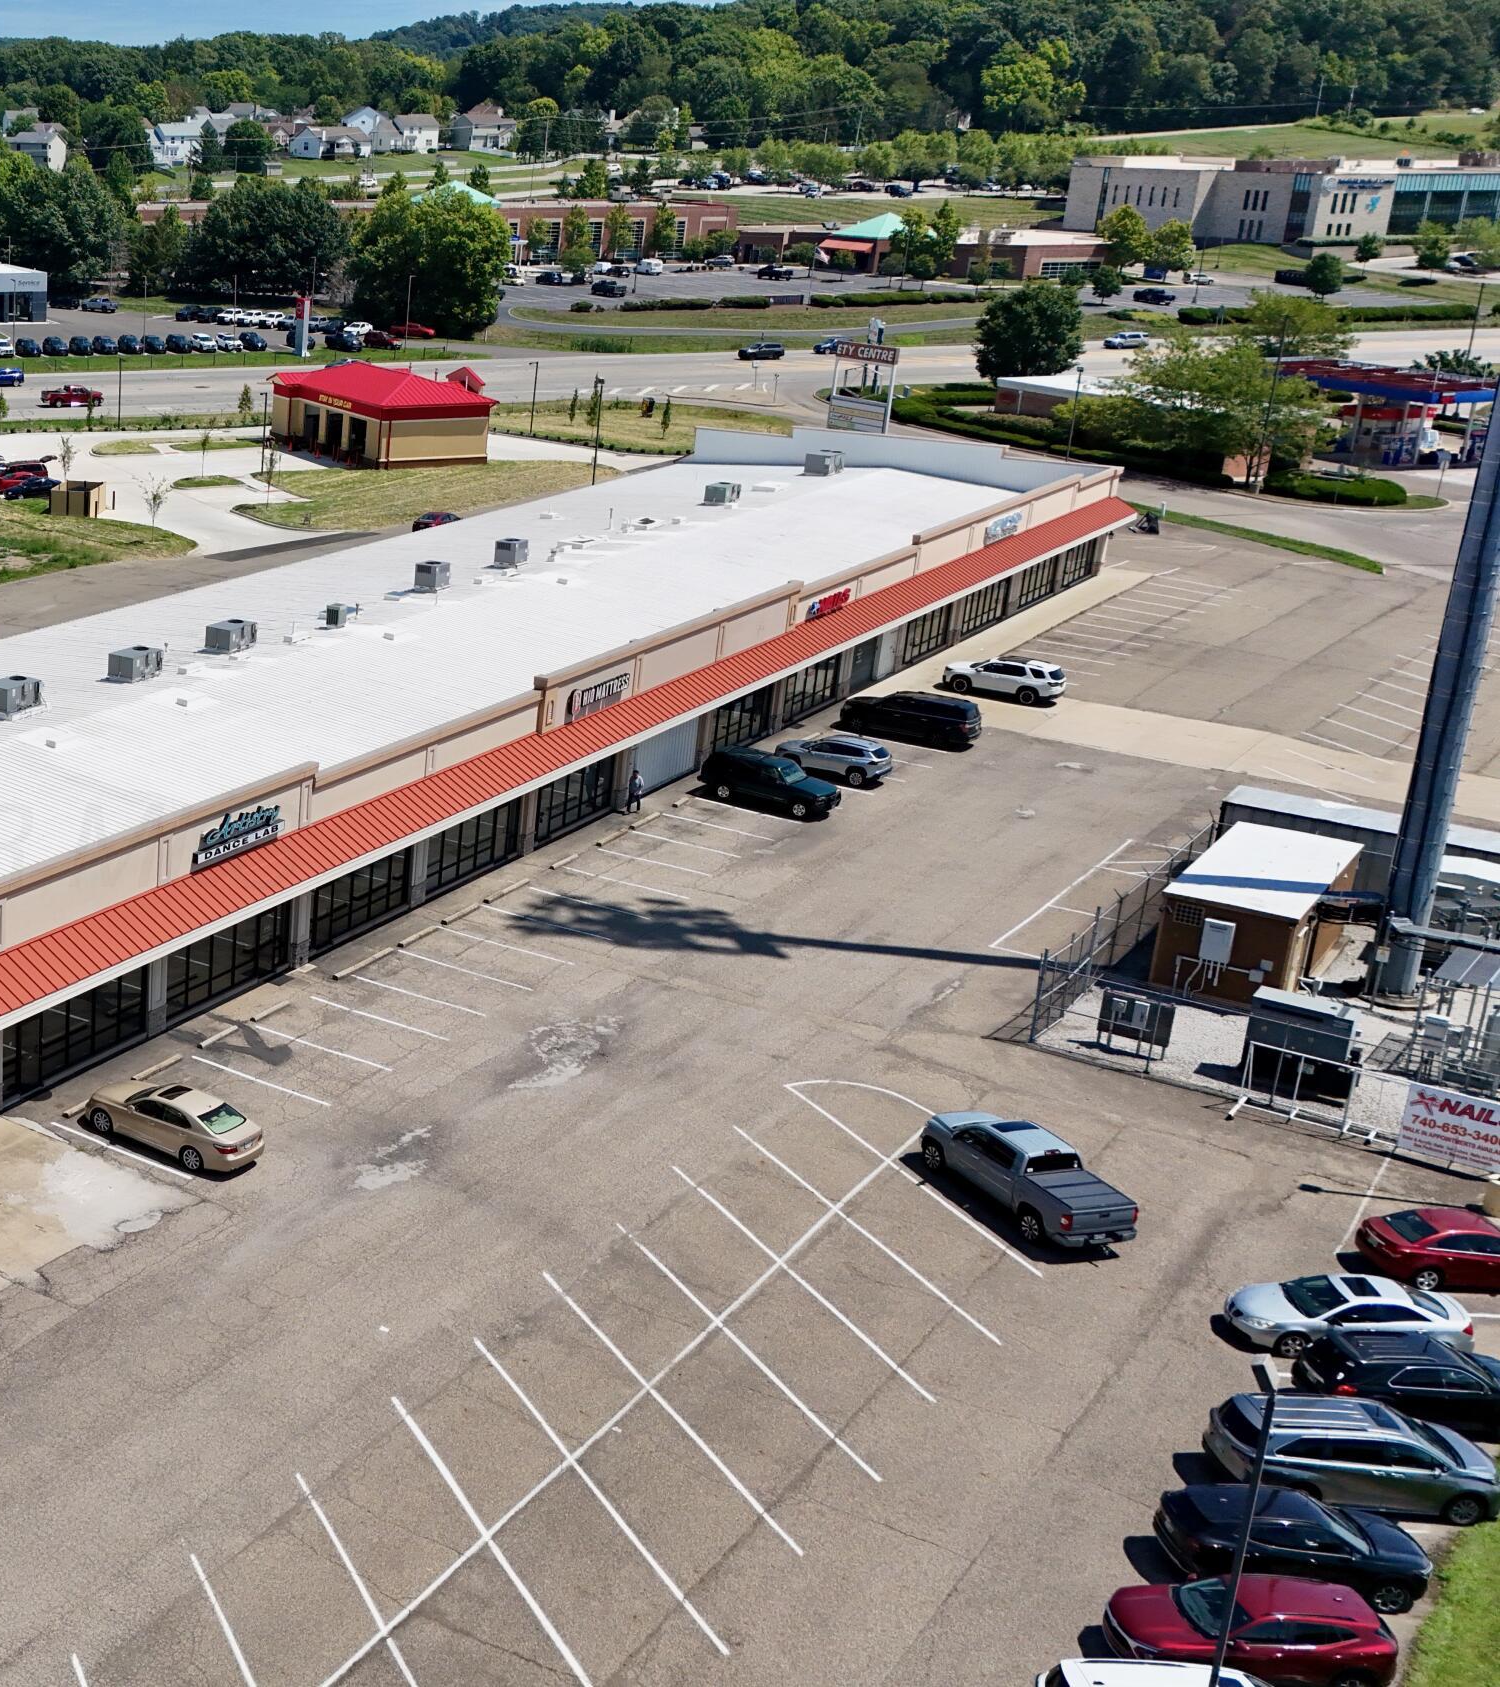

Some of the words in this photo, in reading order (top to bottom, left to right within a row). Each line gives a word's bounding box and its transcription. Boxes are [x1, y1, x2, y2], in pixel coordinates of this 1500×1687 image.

[837, 344, 856, 356] ETY
[857, 346, 895, 361] CENTRE
[596, 673, 630, 701] MATTRESS
[204, 805, 280, 845] Artistry
[204, 836, 249, 860] DANCE
[255, 824, 279, 840] LAB
[1439, 1098, 1500, 1127] NAIL
[1412, 1113, 1500, 1146] 740-653-340
